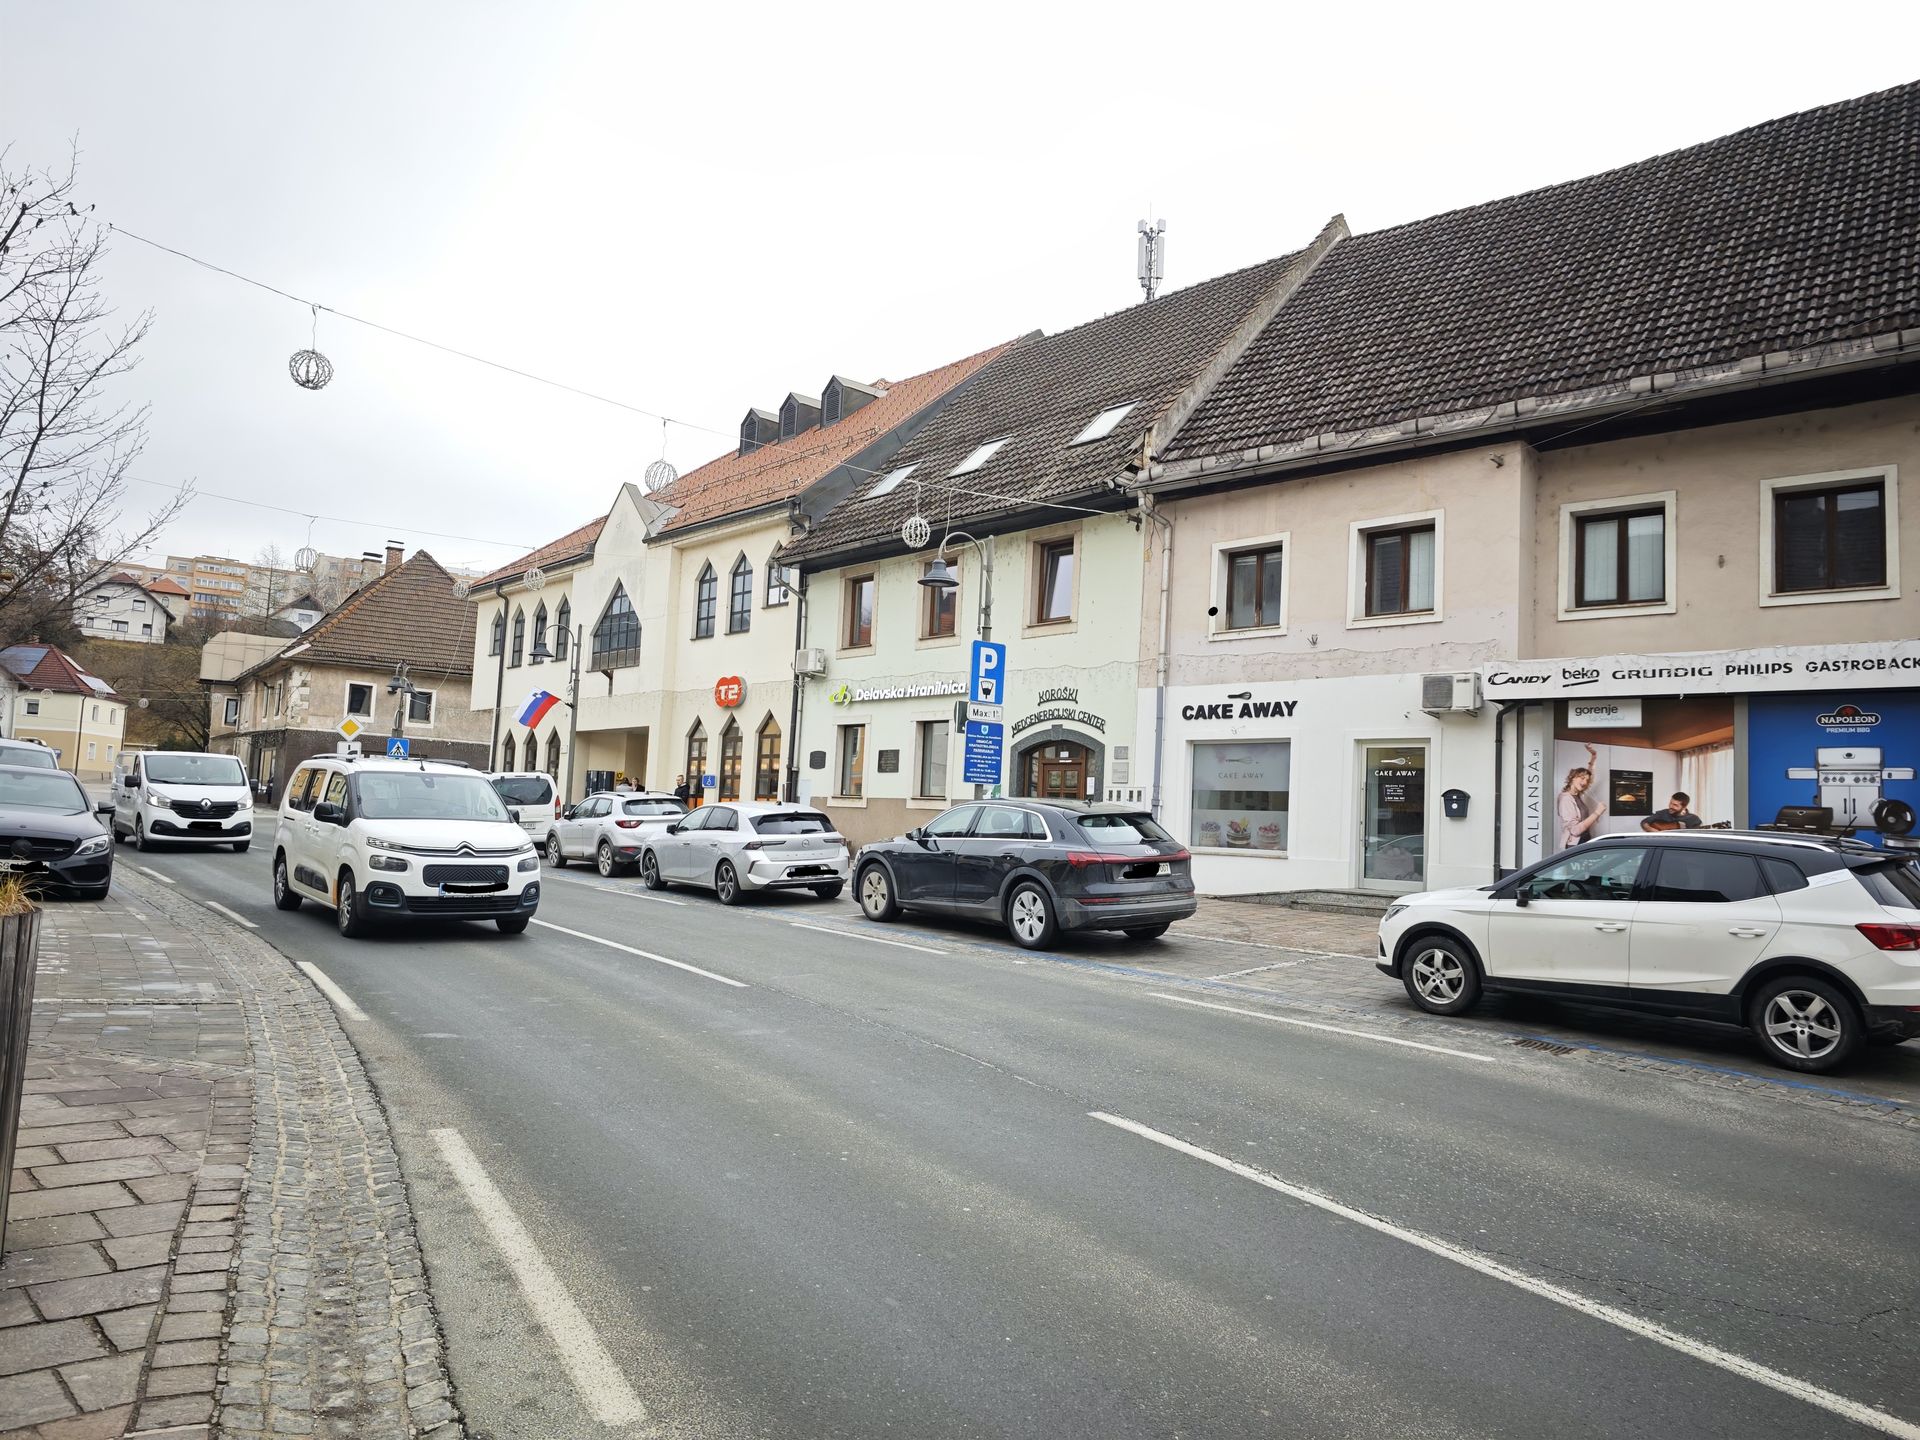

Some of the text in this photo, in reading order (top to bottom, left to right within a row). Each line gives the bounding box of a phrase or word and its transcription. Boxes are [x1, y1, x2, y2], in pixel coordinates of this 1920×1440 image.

[979, 646, 998, 677] P
[1725, 662, 1793, 676] PHILIPS
[1805, 657, 1920, 673] GASTROBACK
[1488, 672, 1552, 685] CANDY
[1562, 667, 1599, 680] beko
[1612, 666, 1713, 680] GRUNDIG
[856, 680, 966, 701] Delavska Hranilnica
[1038, 687, 1078, 704] KOROŠKI
[1181, 700, 1298, 721] CAKE AWAY
[1575, 703, 1618, 717] gorenje
[1078, 710, 1106, 732] CENTER
[1821, 715, 1877, 725] NAPOLEON
[1527, 749, 1540, 845] ALIANSA.si
